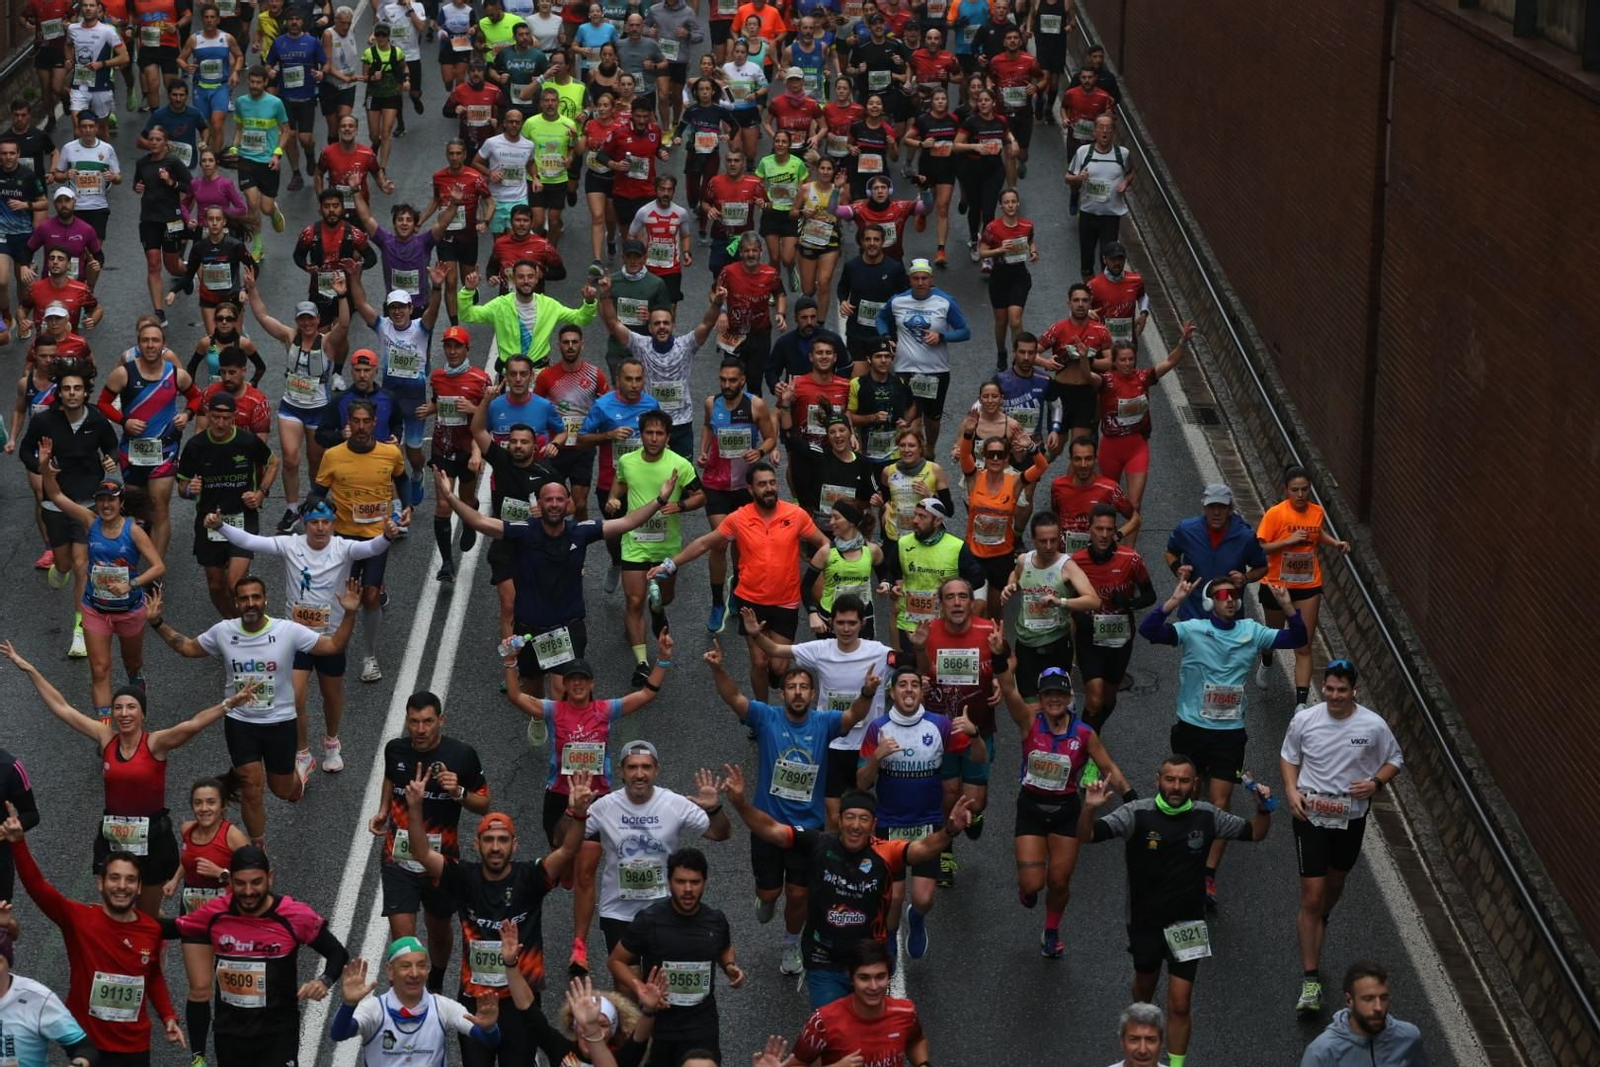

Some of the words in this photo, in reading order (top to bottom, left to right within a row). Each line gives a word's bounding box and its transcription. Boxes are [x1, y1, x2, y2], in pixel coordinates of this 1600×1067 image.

[655, 388, 676, 397] 7489
[359, 504, 381, 514] 5804
[918, 566, 945, 577] Running
[911, 599, 932, 610] 4355
[297, 610, 321, 622] 4042
[540, 640, 563, 655] 8789
[231, 659, 278, 673] indea
[943, 658, 970, 670] 8664
[780, 769, 807, 785] 7890
[621, 814, 660, 824] boreas
[625, 871, 653, 883] 9849
[828, 910, 866, 926] Sigfrido
[475, 951, 504, 966] 6796
[223, 972, 253, 987] 5609
[669, 973, 701, 987] 9563
[100, 985, 133, 1001] 9113
